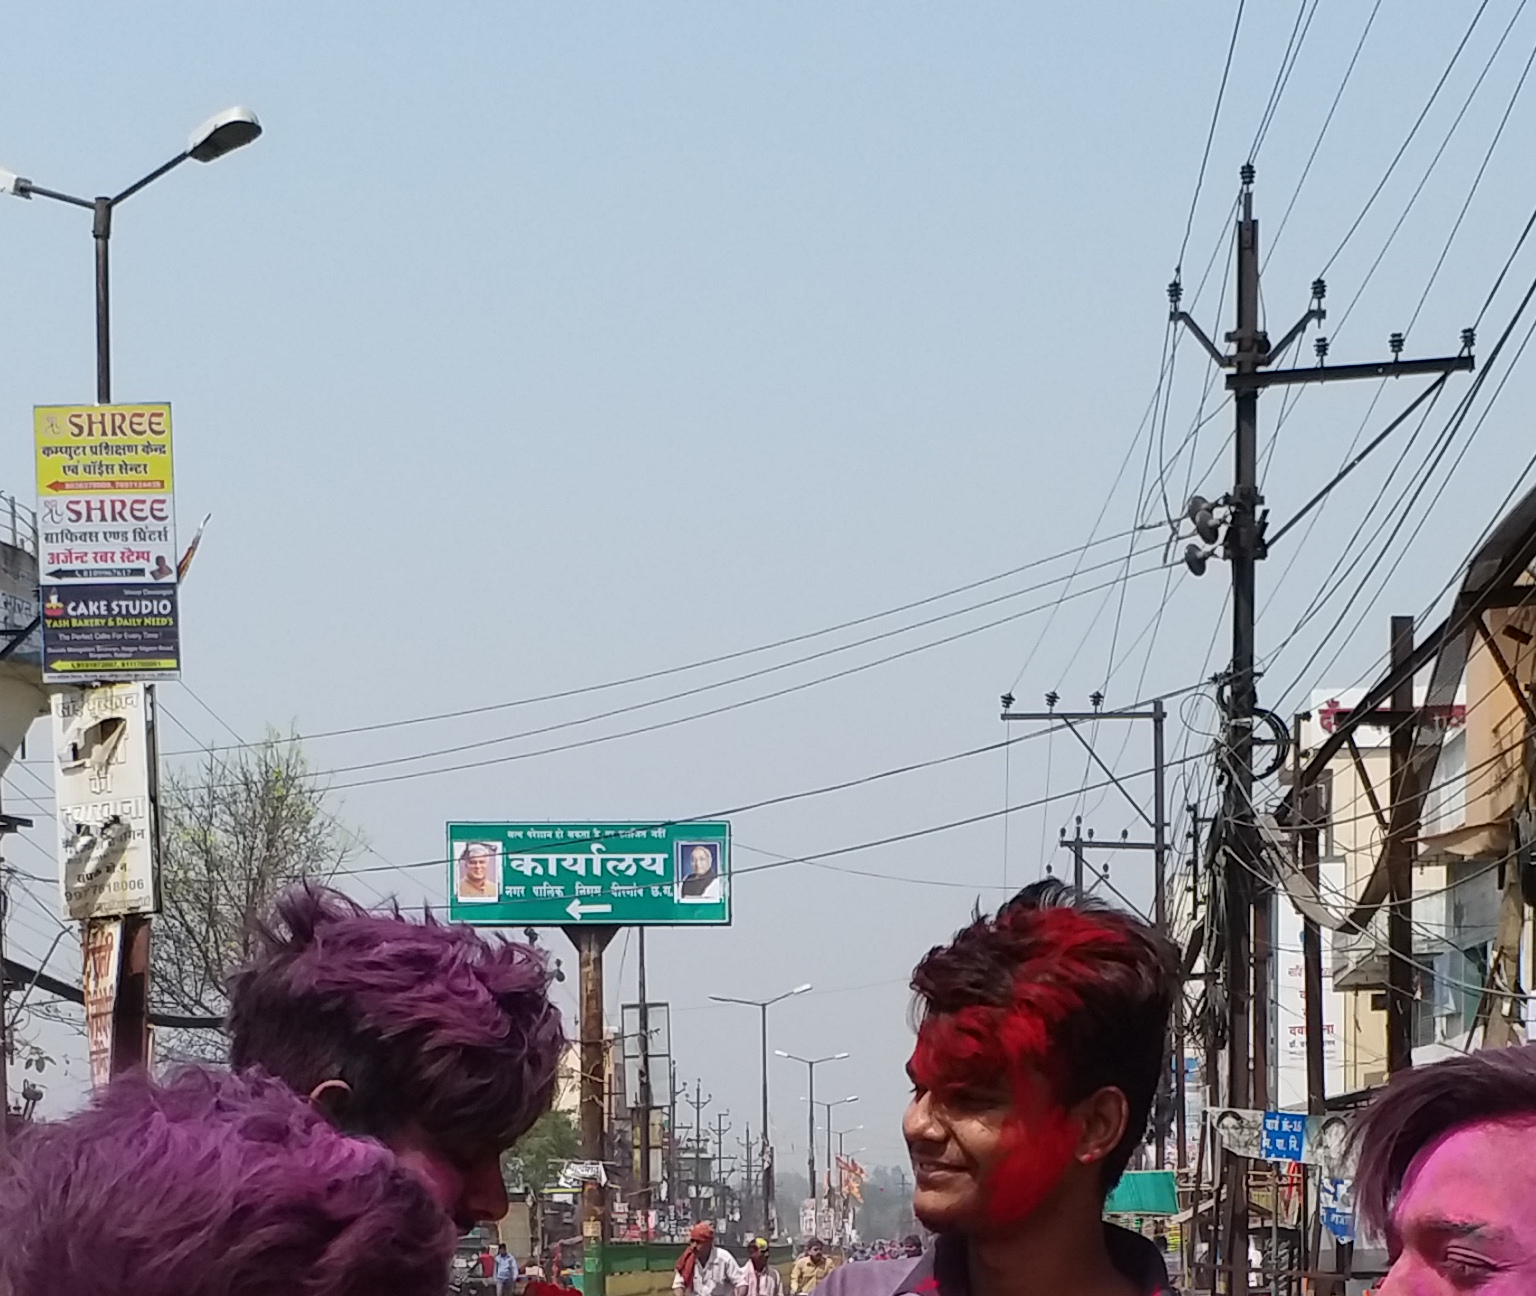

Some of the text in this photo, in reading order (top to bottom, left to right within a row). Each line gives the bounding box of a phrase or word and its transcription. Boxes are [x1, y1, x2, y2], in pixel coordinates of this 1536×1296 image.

[68, 411, 166, 437] SHREE
[66, 498, 169, 523] SHREE
[67, 599, 172, 616] CAKE STUDIO
[45, 618, 69, 628] YASH
[72, 617, 106, 628] BAKERY
[108, 617, 115, 627] &
[116, 616, 142, 627] DAILY
[508, 842, 669, 877] कार्यालय
[505, 885, 526, 898] नगर
